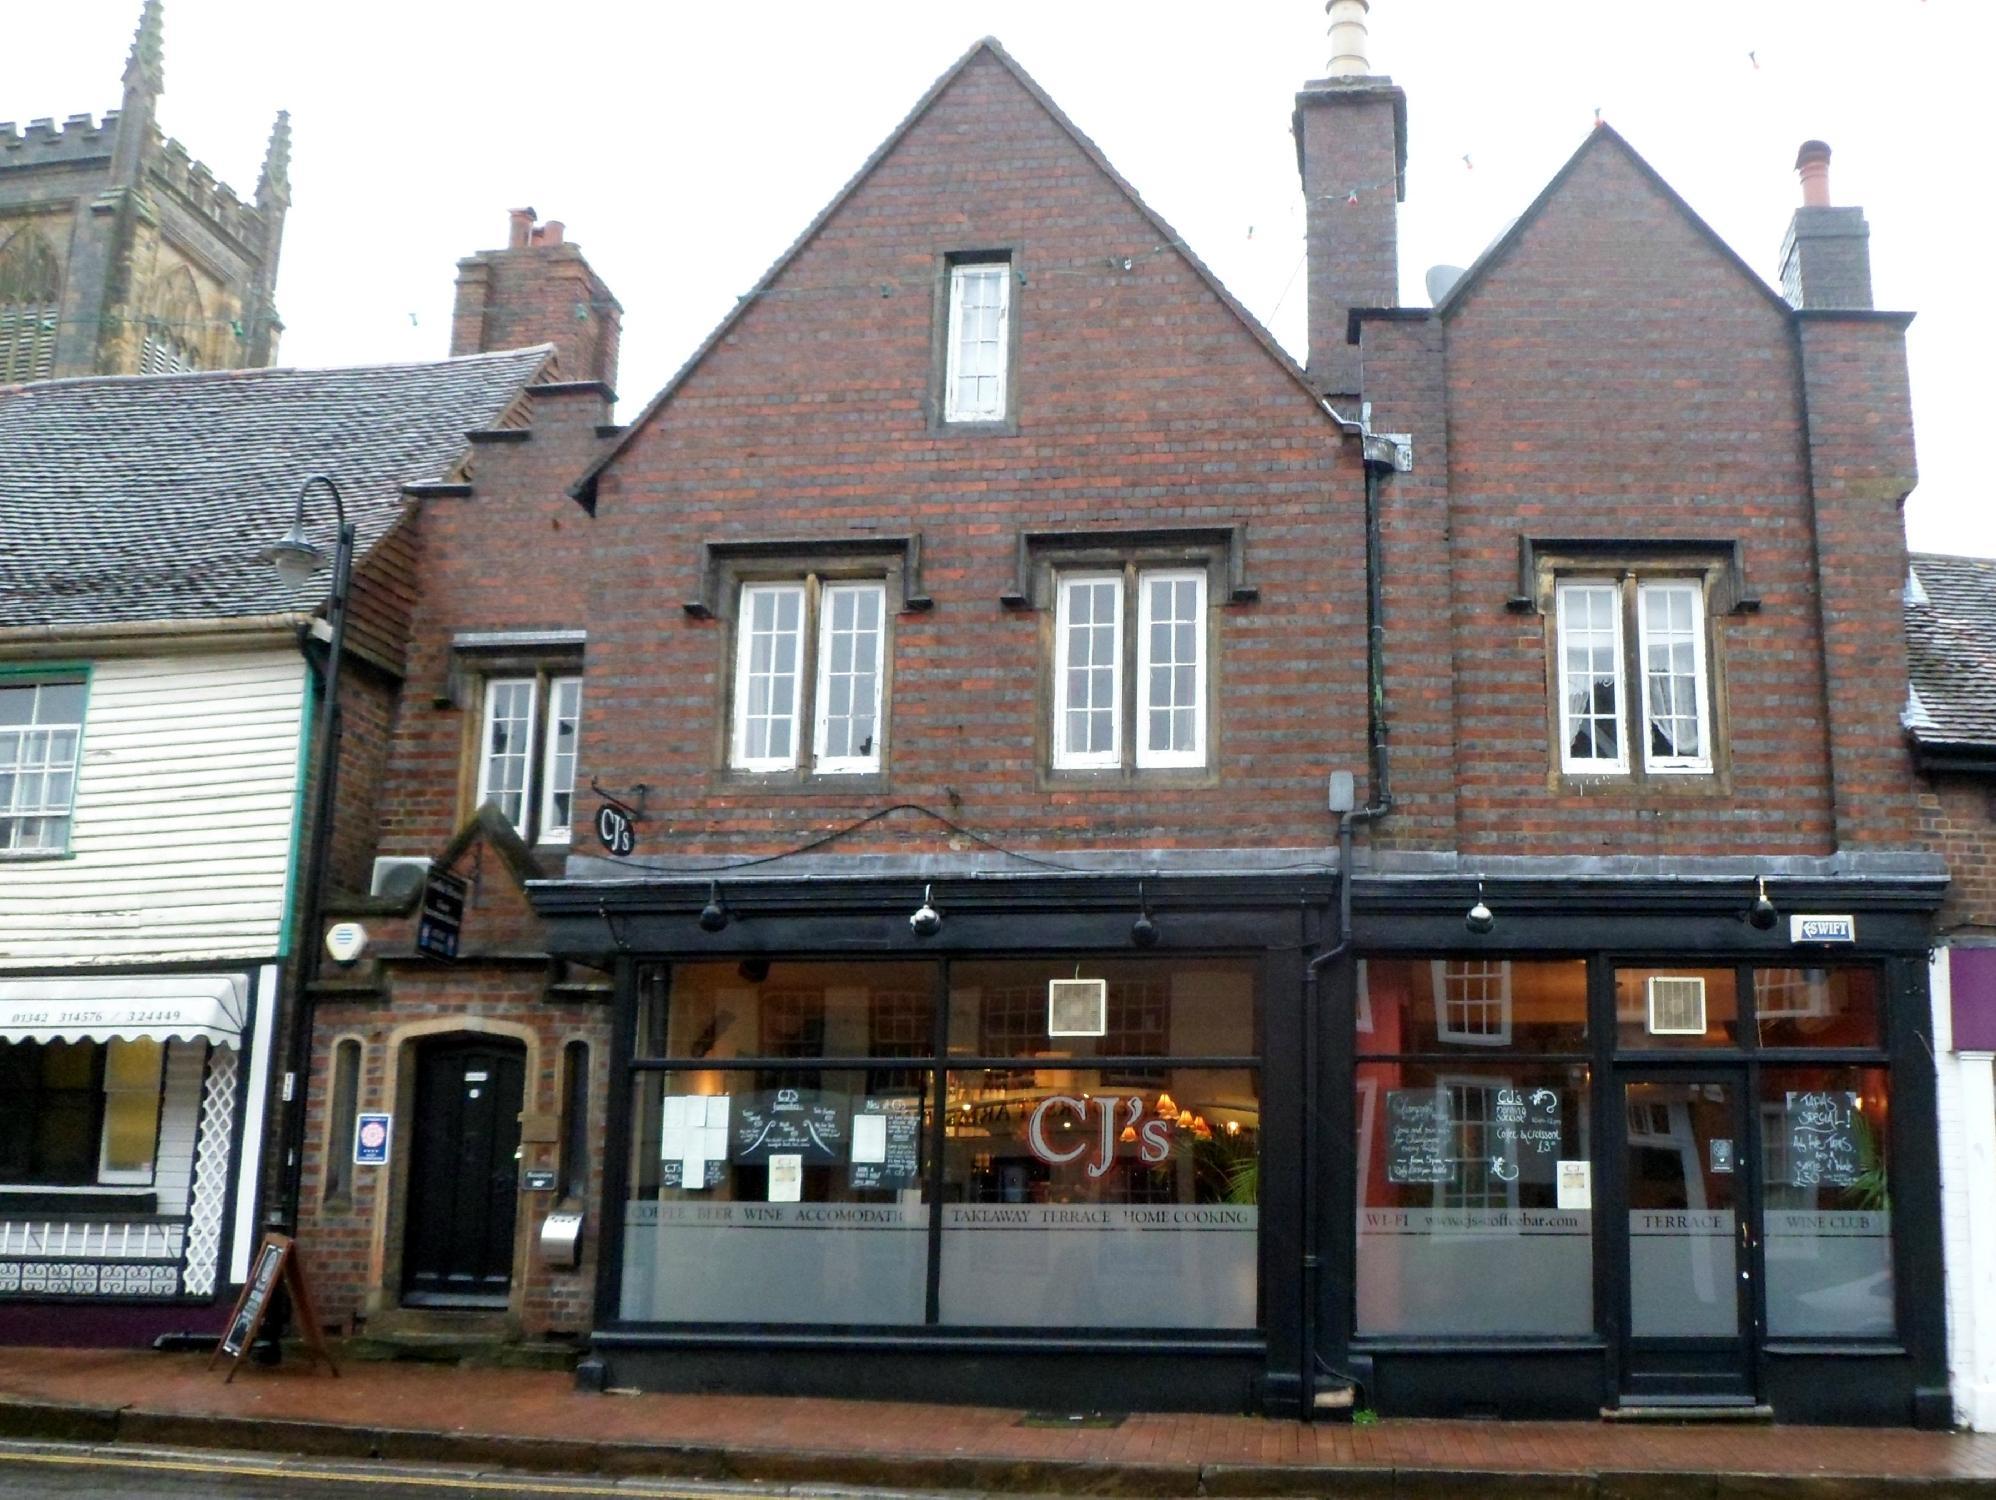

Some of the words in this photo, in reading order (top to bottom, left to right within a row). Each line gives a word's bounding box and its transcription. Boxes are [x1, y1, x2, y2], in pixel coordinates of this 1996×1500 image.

[601, 809, 629, 851] CJ's
[1808, 921, 1847, 935] SWIFT
[12, 1012, 49, 1023] 01342
[59, 1010, 103, 1022] 314576
[127, 1010, 181, 1021] 324449
[1028, 1096, 1170, 1177] CJ's
[696, 1206, 733, 1221] BEER
[743, 1207, 784, 1221] WINE
[795, 1208, 914, 1222] ACCOMODATI
[952, 1209, 1031, 1224] TAKEAWAY
[1040, 1209, 1111, 1224] TERRACE
[1123, 1210, 1169, 1224] HOME
[1174, 1210, 1249, 1225] COOKING
[1366, 1213, 1409, 1227] WI-FI
[1643, 1215, 1722, 1229] TERRACE
[1786, 1216, 1825, 1229] WINE
[1830, 1216, 1871, 1229] CLUB
